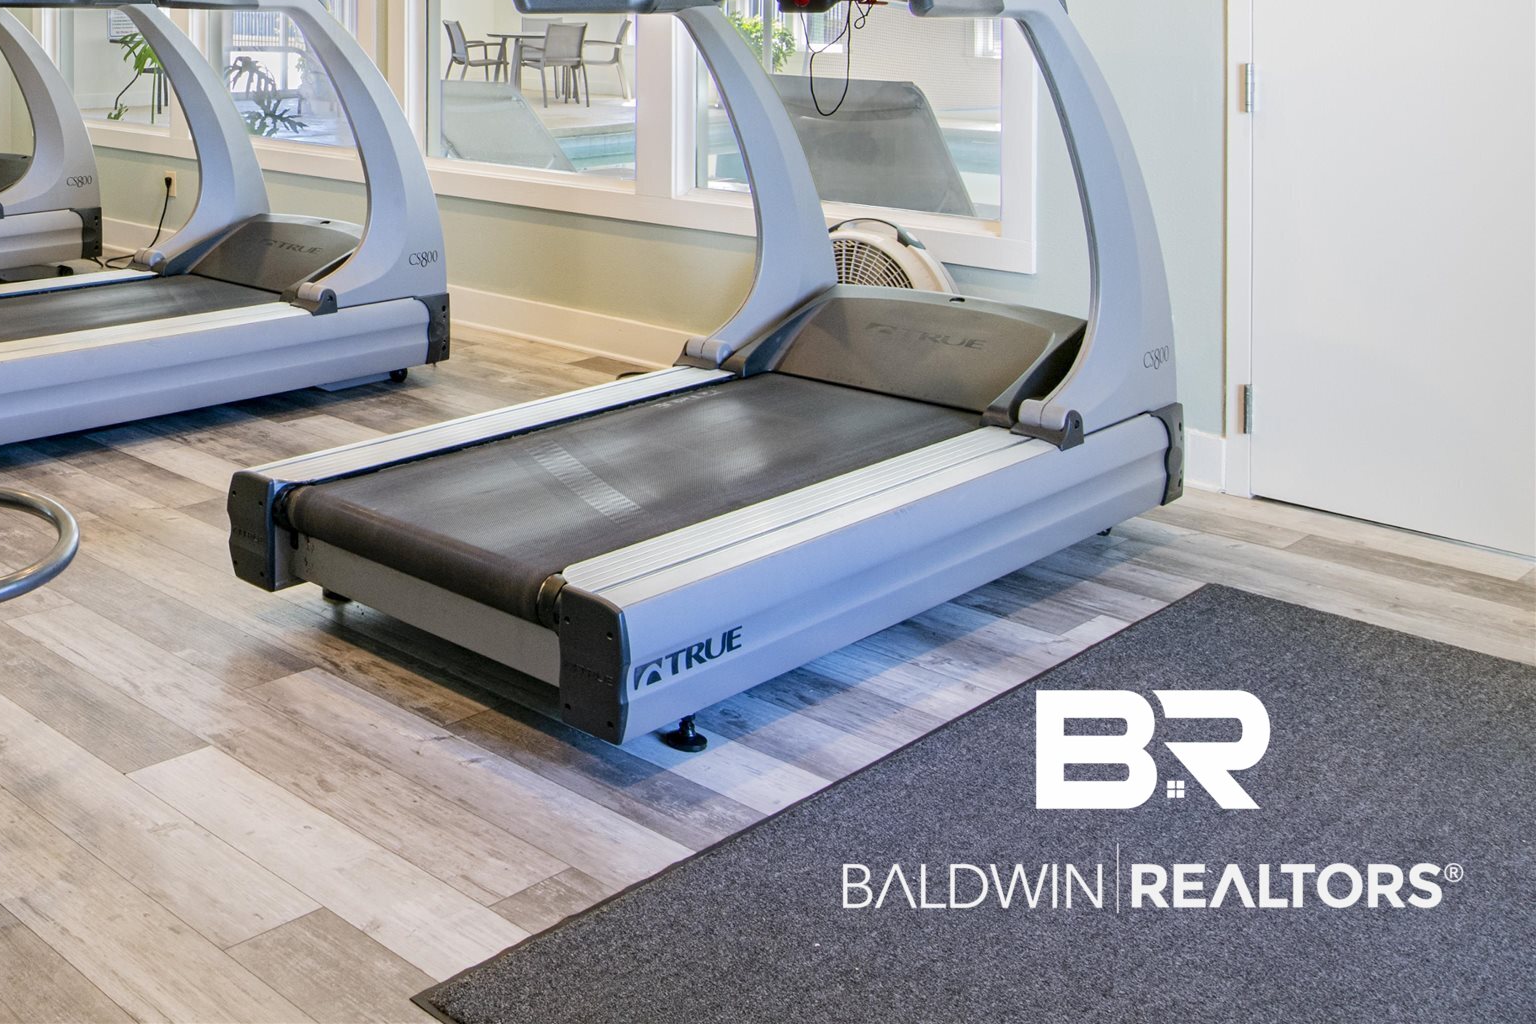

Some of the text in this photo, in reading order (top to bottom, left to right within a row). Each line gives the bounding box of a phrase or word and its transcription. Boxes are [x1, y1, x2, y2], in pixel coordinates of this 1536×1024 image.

[66, 175, 93, 188] CS800
[277, 240, 323, 255] TRUE
[408, 249, 439, 268] CS800
[898, 328, 987, 351] TRUE
[1142, 345, 1170, 370] CS800
[664, 625, 743, 675] TRUE
